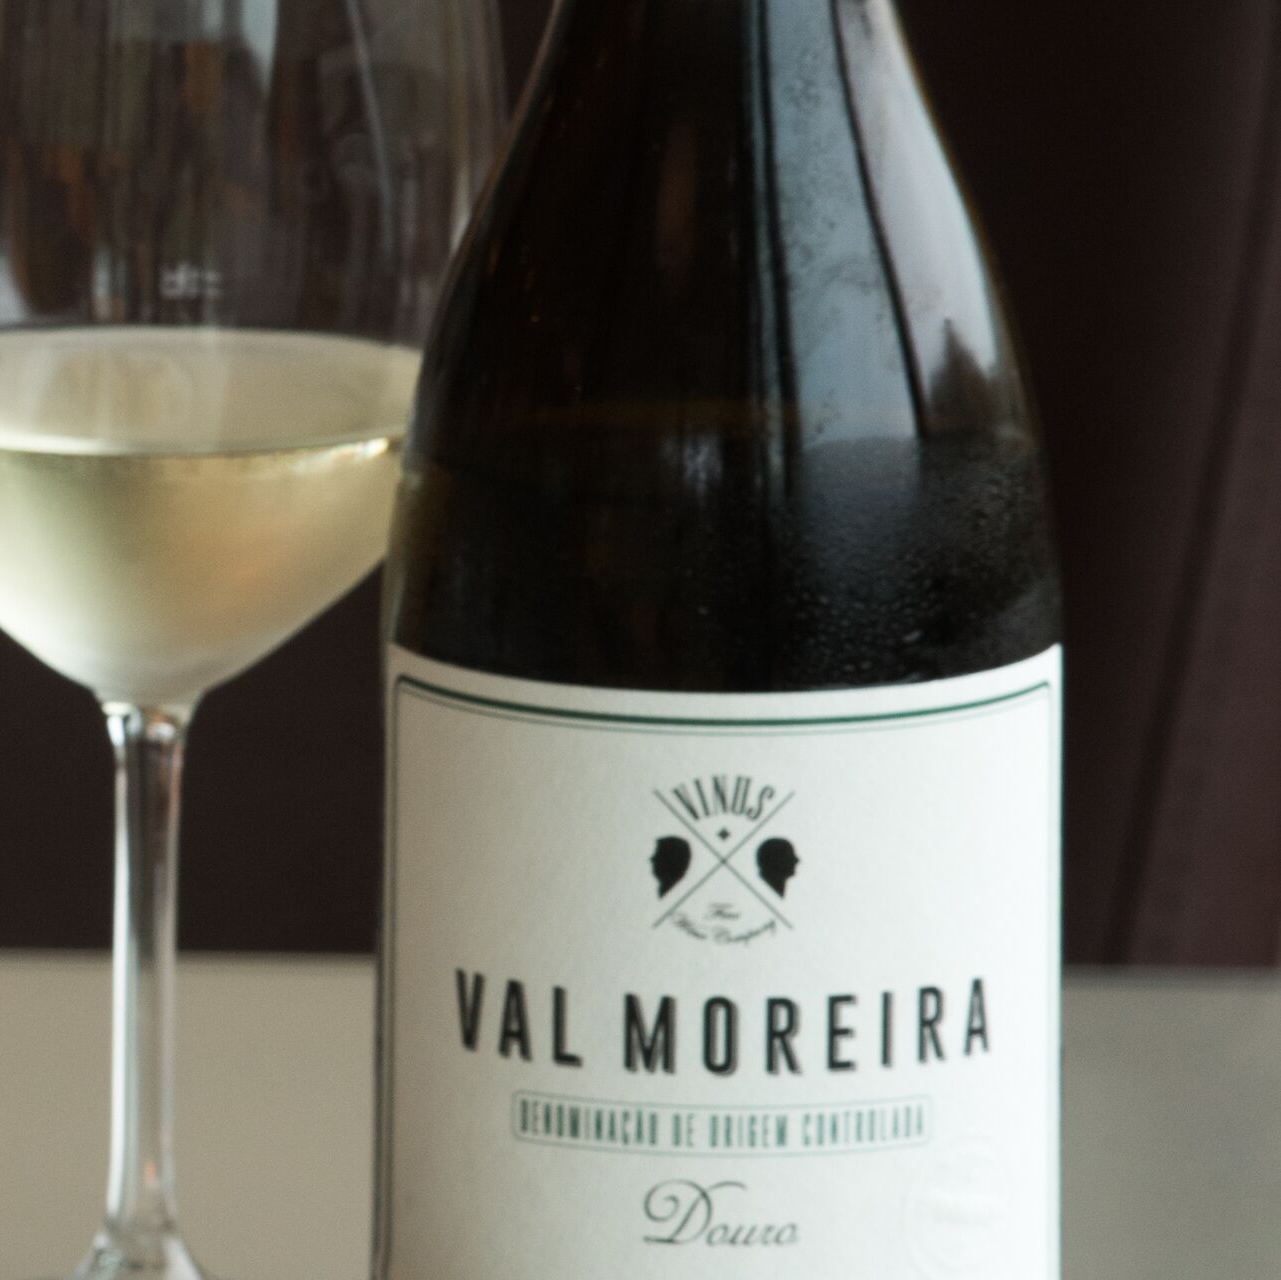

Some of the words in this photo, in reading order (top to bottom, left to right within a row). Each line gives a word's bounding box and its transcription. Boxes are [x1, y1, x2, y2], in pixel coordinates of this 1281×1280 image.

[672, 774, 776, 822] VINUS
[455, 968, 584, 1068] VAL
[623, 976, 991, 1076] MOREIRA
[672, 1112, 694, 1148] DE
[709, 1113, 787, 1148] ORIGEM
[802, 1104, 924, 1146] CONTROLADA
[643, 1178, 799, 1246] Douro
